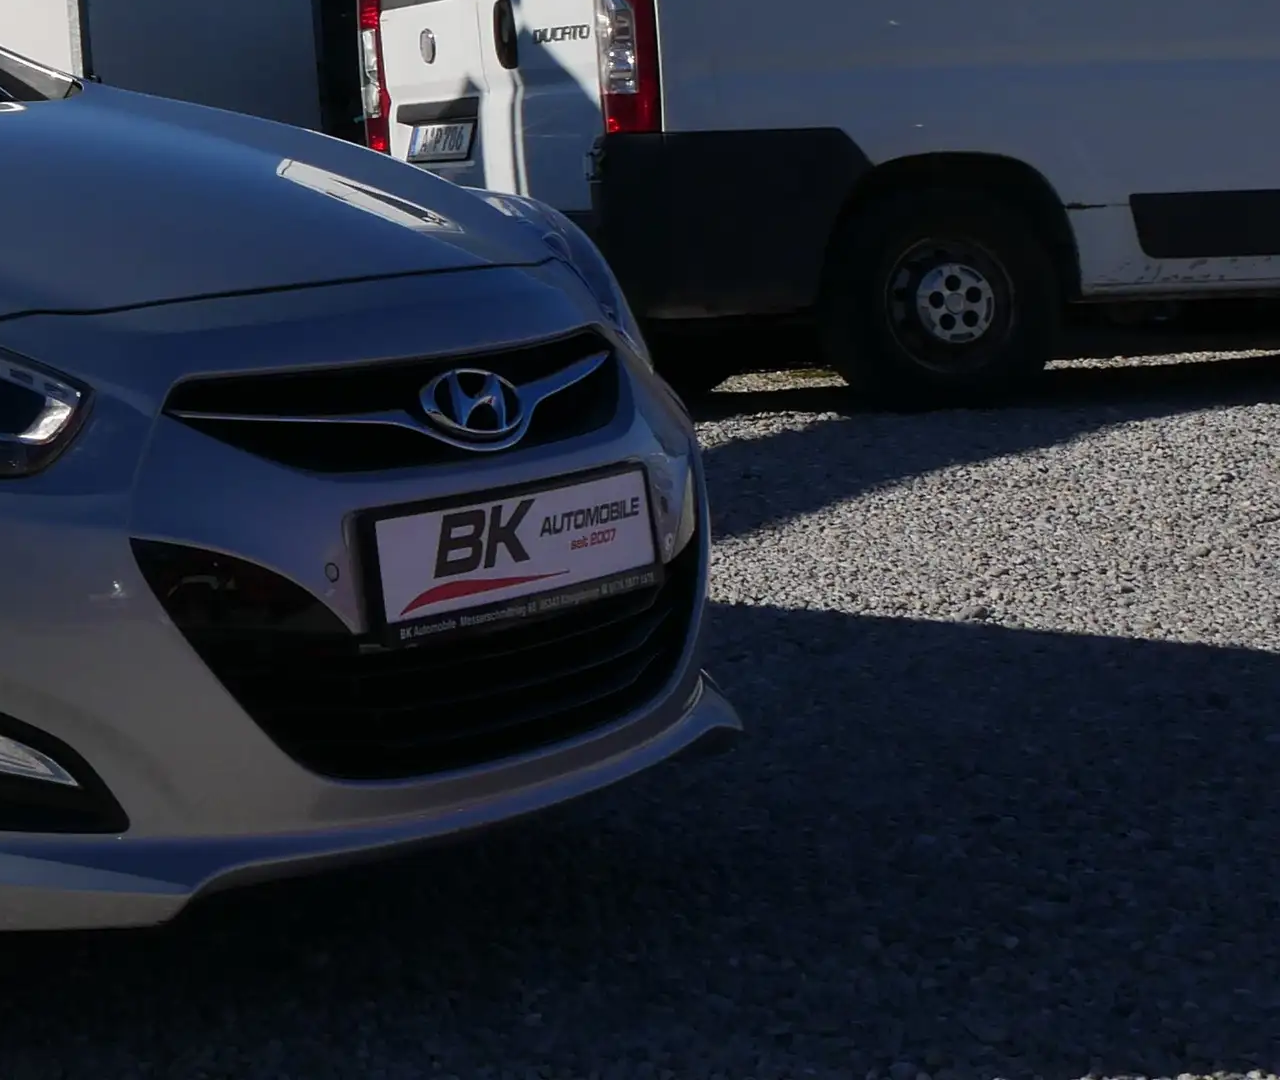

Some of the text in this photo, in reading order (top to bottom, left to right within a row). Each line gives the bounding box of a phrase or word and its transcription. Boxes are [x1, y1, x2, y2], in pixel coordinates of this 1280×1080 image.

[532, 24, 590, 44] DUCATO
[434, 496, 640, 579] BK AUTOMOBILE
[570, 528, 617, 551] seit 2007
[400, 626, 413, 640] BK
